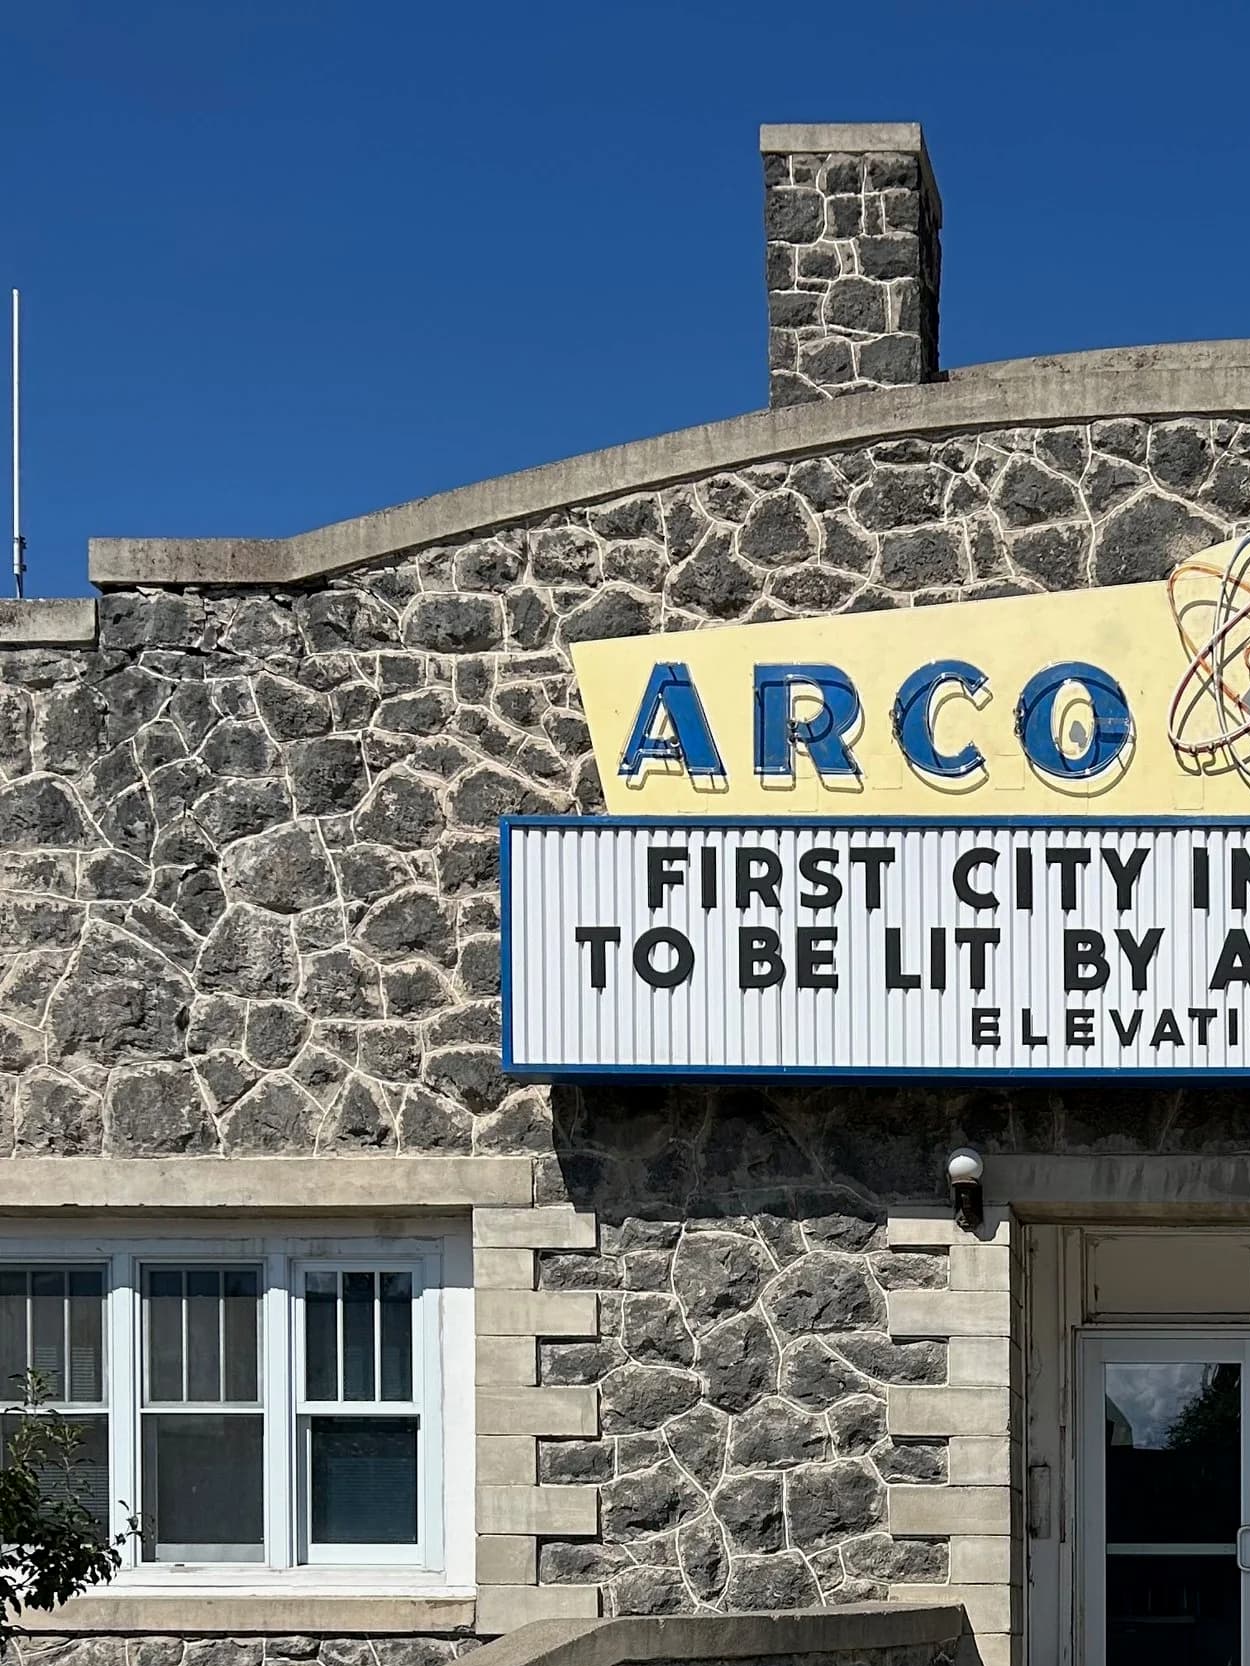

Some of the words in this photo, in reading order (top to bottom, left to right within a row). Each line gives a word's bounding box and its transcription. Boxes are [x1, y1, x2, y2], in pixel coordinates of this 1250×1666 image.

[616, 657, 1134, 778] ARCO
[647, 846, 896, 910] FIRST
[952, 846, 1149, 910] CITY
[575, 925, 696, 991] TO
[738, 926, 839, 990] BE
[885, 926, 1001, 991] LIT
[1063, 927, 1165, 991] BY
